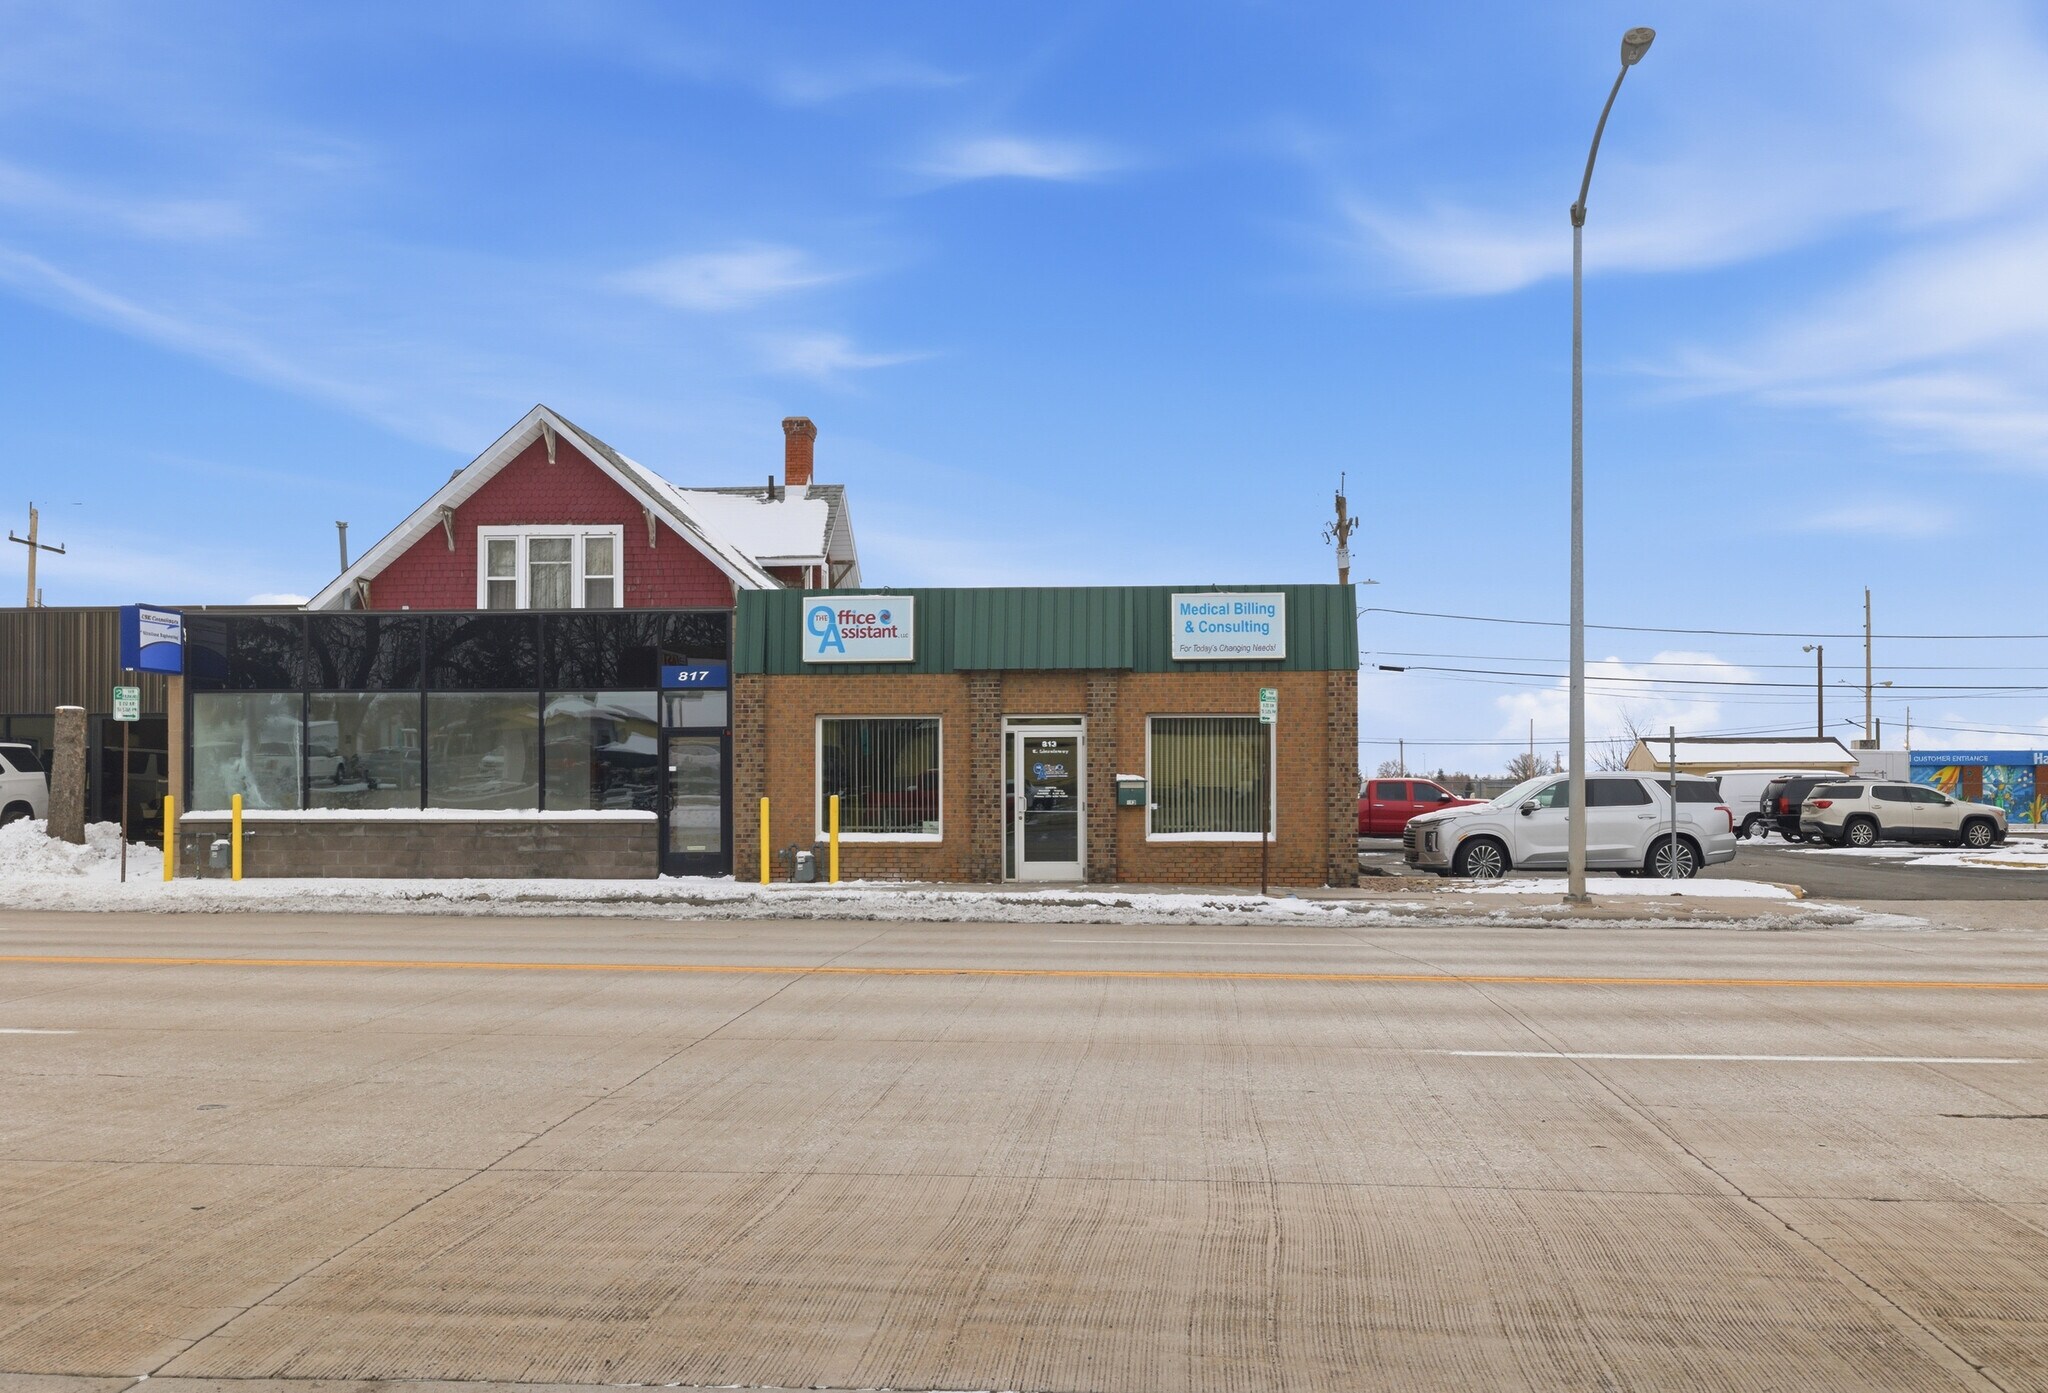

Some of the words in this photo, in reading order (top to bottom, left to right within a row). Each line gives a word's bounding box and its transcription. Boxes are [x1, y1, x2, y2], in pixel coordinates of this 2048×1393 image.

[1180, 602, 1230, 616] Medical
[1234, 602, 1275, 617] Billing
[815, 614, 828, 622] THE
[1185, 620, 1194, 633] &
[1198, 620, 1270, 636] Consulting
[1180, 644, 1191, 653] For
[1193, 644, 1217, 654] Today's
[1219, 643, 1251, 653] Changing
[1252, 643, 1276, 652] Needs!
[678, 671, 710, 681] 817
[116, 689, 122, 699] 2
[1041, 740, 1057, 748] 813
